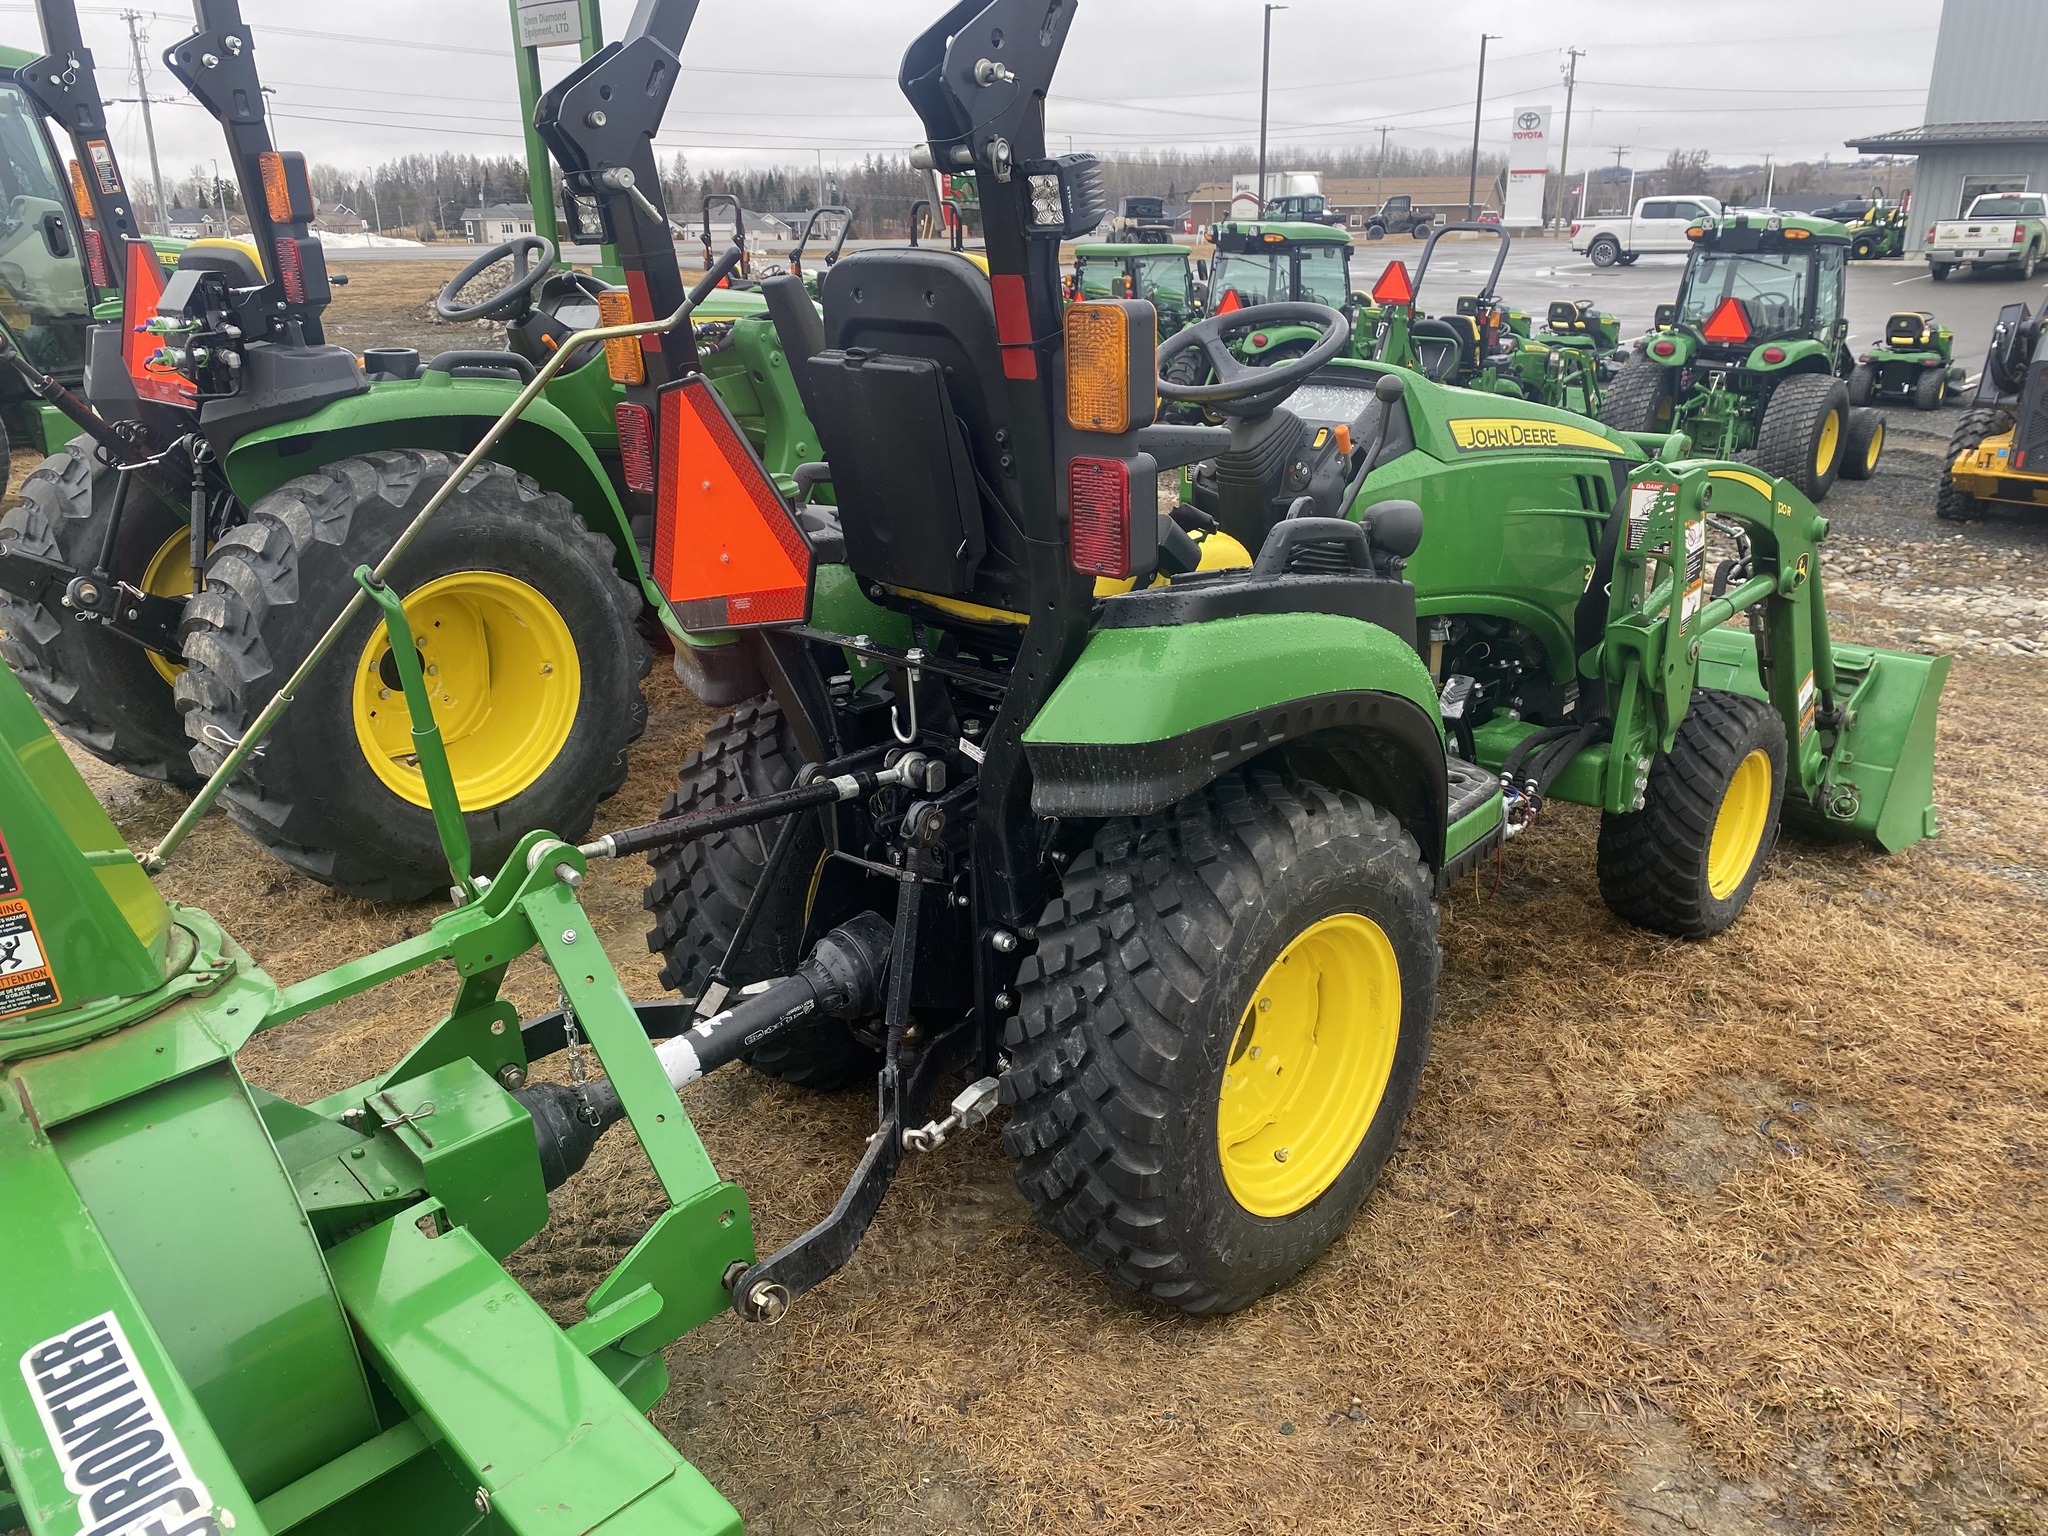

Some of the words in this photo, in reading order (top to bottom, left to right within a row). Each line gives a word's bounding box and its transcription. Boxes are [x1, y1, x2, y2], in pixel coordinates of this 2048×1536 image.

[524, 16, 538, 26] Green
[539, 11, 567, 23] Diamond
[525, 25, 554, 39] Equipment,
[556, 23, 569, 33] LTD
[1513, 131, 1543, 139] TOYOTA
[158, 255, 179, 263] EER
[1467, 426, 1509, 446] JOHN
[1511, 425, 1558, 444] DEERE
[5, 913, 27, 922] HAZARD
[0, 968, 47, 988] TTENTION
[14, 981, 46, 992] PROJECTION
